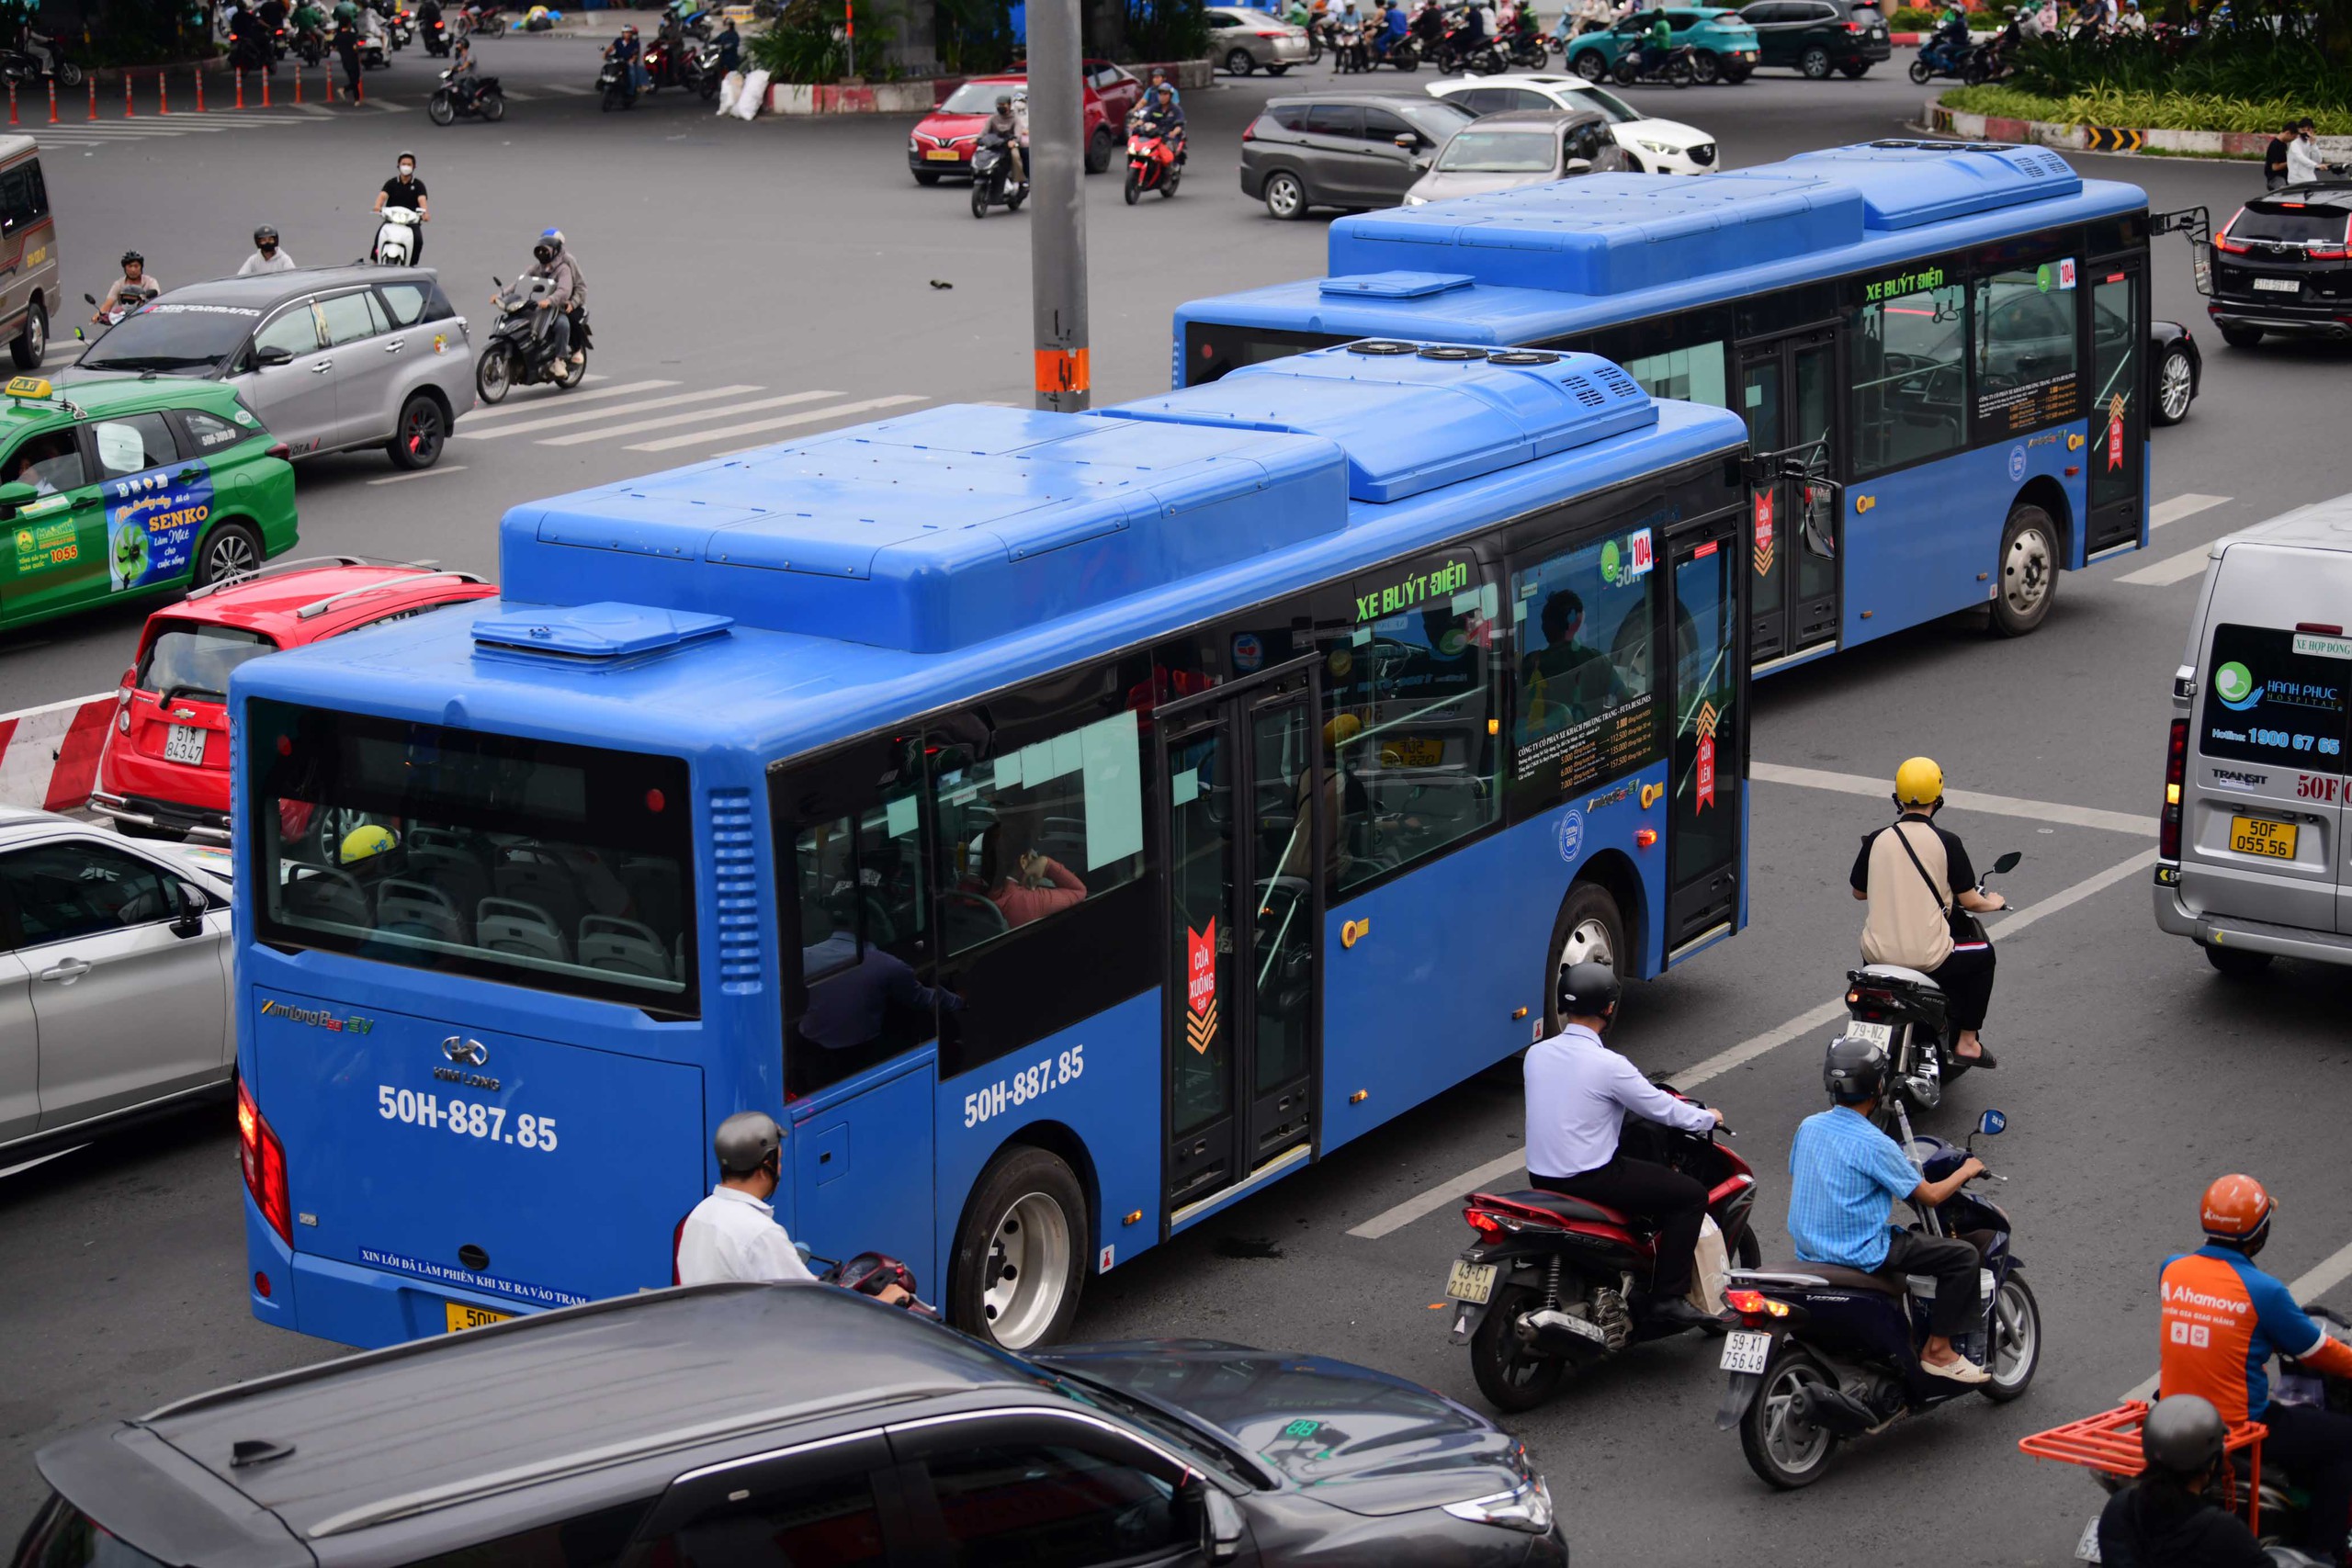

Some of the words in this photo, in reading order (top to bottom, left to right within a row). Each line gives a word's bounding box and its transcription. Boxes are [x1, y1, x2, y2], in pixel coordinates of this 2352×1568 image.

[1866, 283, 1882, 301] XE
[1884, 273, 1915, 296] BUÝT
[1917, 266, 1943, 292] ĐIỆN
[2061, 263, 2075, 284] 104
[149, 505, 209, 533] SENKO
[51, 545, 78, 563] 1055
[1634, 536, 1651, 567] 104
[1356, 592, 1379, 623] XE
[1383, 573, 1427, 614] BUÝT
[1430, 560, 1467, 596] ĐIỆN
[2297, 639, 2307, 650] XE
[2267, 693, 2335, 707] HOSPITAL
[176, 726, 197, 744] 51A
[2212, 728, 2246, 742] Hotline:
[2248, 728, 2290, 748] 1900
[2292, 733, 2315, 751] 67
[2317, 737, 2340, 755] 65
[166, 741, 202, 762] 843.47
[1561, 752, 1573, 765] 5.000
[1611, 729, 1628, 744] 112.500
[1561, 765, 1573, 777] 6.000
[1611, 741, 1628, 755] 135.000
[1561, 778, 1573, 790] 7.000
[1611, 755, 1628, 769] 157.500
[1701, 763, 1711, 784] LÊN
[2212, 768, 2268, 784] TRANSIT
[2249, 821, 2278, 838] 50F
[2237, 835, 2287, 856] 055.56
[1194, 944, 1209, 971] CỬA
[1190, 969, 1215, 999] XUỐNG
[1198, 998, 1206, 1010] Exit
[1852, 1023, 1884, 1040] 79-N2
[434, 1066, 460, 1082] KIM
[463, 1072, 500, 1091] LONG
[965, 1043, 1084, 1128] 50H-887.85
[379, 1085, 558, 1152] 50H-887.85
[362, 1250, 379, 1262] XIN
[382, 1254, 400, 1267] LỖI
[401, 1258, 416, 1271] ĐÃ
[418, 1262, 441, 1277] LÀM
[477, 1275, 496, 1289] KHI
[498, 1280, 513, 1292] XE
[514, 1284, 529, 1296] RA
[530, 1286, 552, 1301] VÀO
[1458, 1264, 1488, 1283] 43-C1
[1450, 1280, 1488, 1301] 219.78
[1806, 1294, 1850, 1303] VISION
[2172, 1285, 2247, 1314] Ahamove
[2179, 1310, 2192, 1318] GIA
[2194, 1313, 2211, 1322] GIAO
[1732, 1334, 1762, 1352] 59-X1
[1724, 1351, 1763, 1371] 756.48
